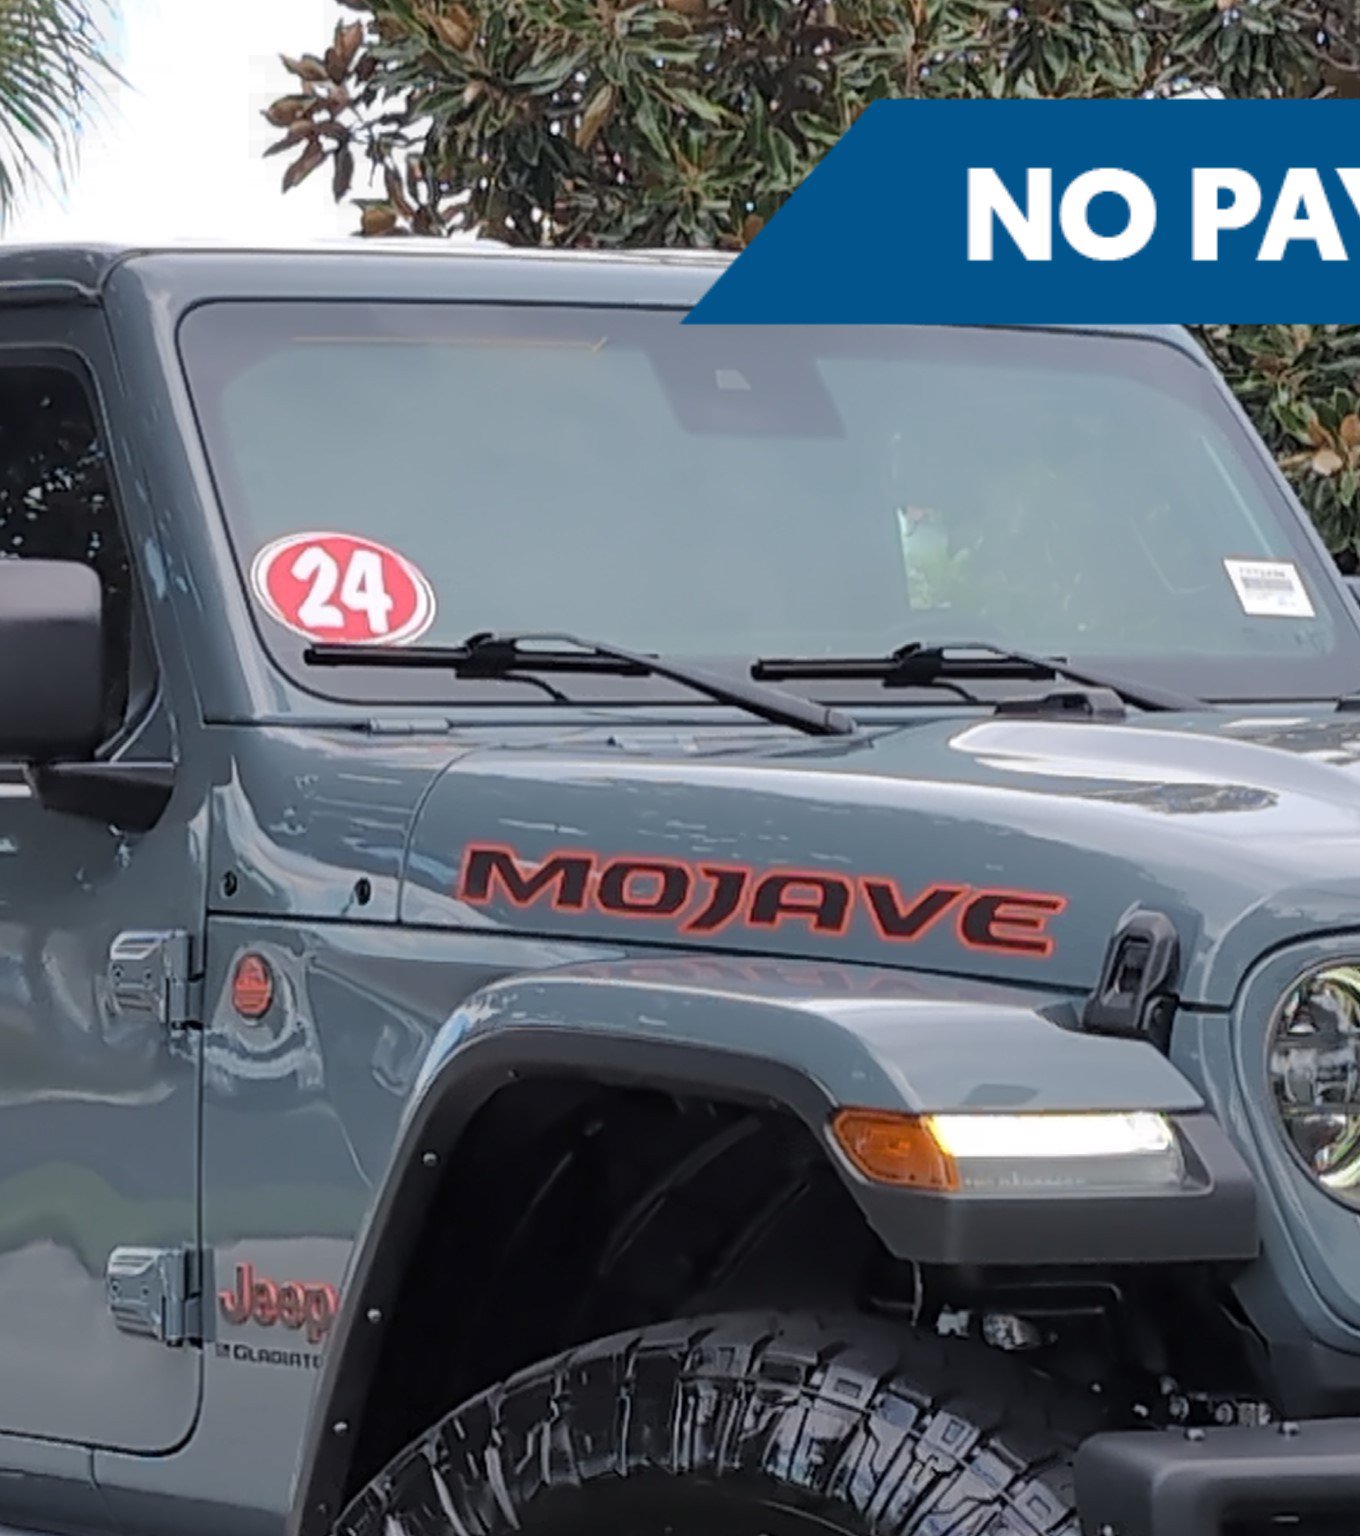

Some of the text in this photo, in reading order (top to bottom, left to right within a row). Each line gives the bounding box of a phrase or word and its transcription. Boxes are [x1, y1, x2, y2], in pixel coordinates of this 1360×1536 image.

[291, 546, 393, 634] 24
[460, 842, 1066, 956] MOJAVE
[217, 1261, 339, 1345] Jeep
[232, 1344, 324, 1370] GLADIATO
